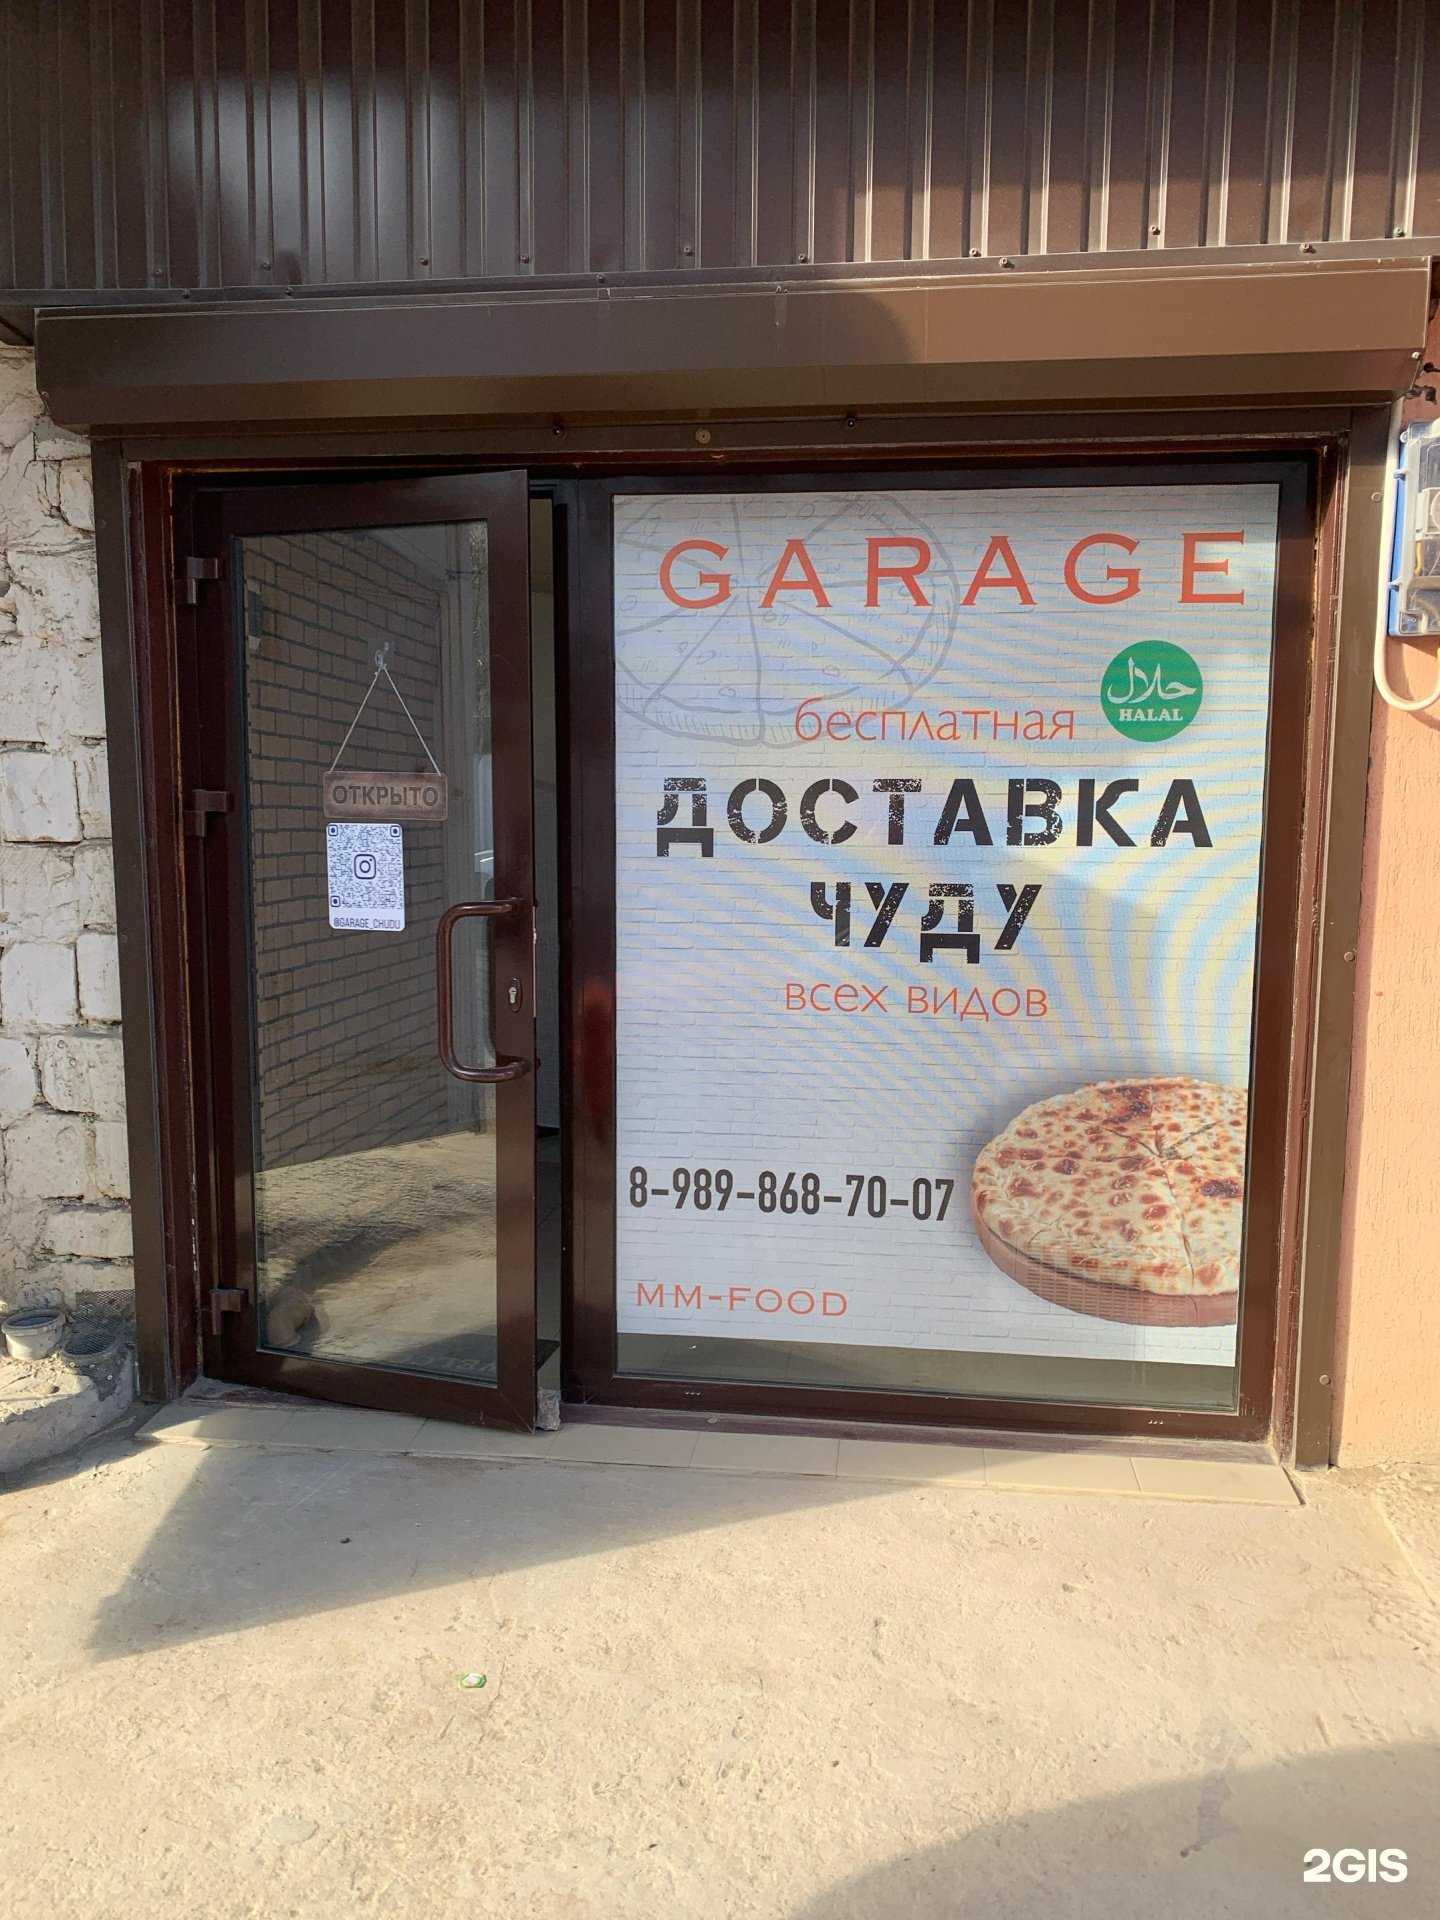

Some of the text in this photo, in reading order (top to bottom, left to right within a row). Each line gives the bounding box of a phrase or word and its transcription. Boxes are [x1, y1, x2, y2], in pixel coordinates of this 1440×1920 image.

[659, 529, 1246, 609] GARAGE
[1107, 656, 1198, 705] حلال
[794, 696, 1075, 742] бесплатная
[1118, 708, 1184, 722] HALAL
[332, 785, 439, 807] ОТКРЫТО
[656, 777, 1214, 858] ДОСТАВКА
[333, 917, 401, 930] @GARAGE_CHUDU
[809, 881, 1043, 964] ЧУДУ
[629, 1165, 954, 1222] 8-989-868-70-07
[635, 1281, 849, 1318] MM-FOOD
